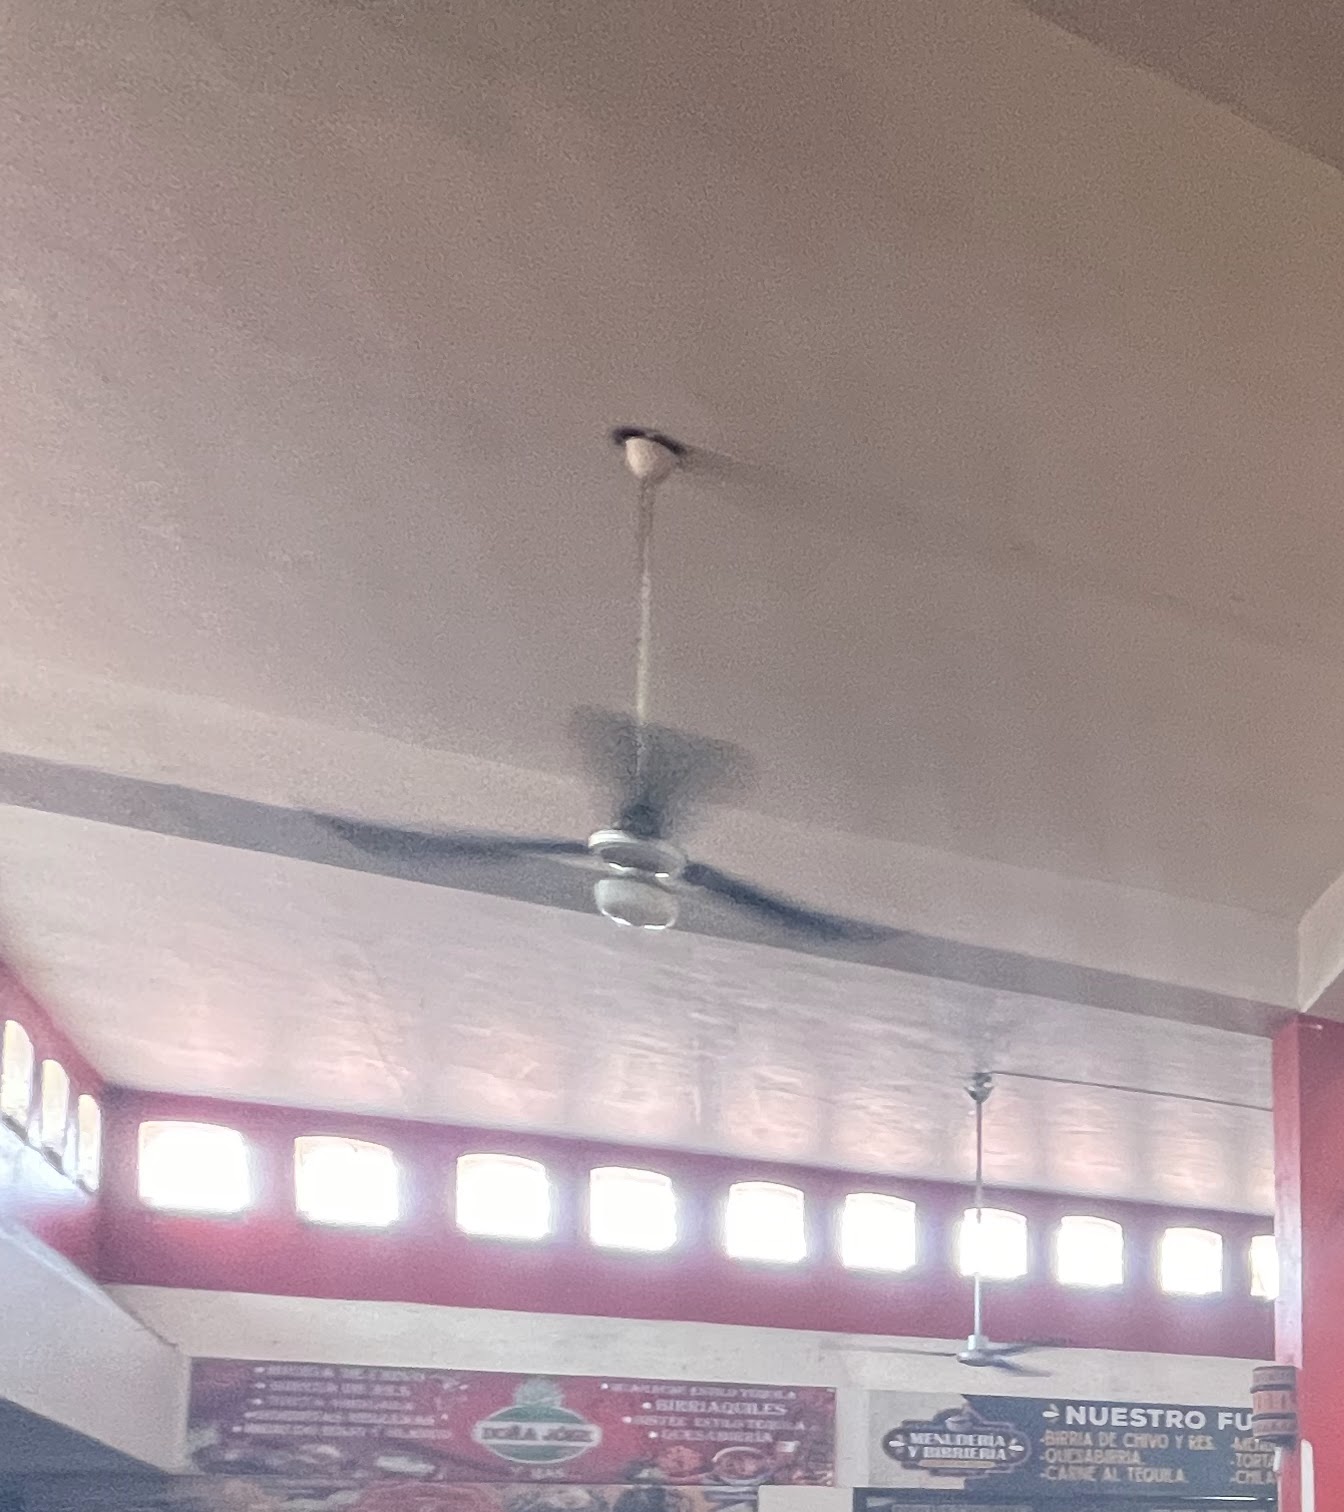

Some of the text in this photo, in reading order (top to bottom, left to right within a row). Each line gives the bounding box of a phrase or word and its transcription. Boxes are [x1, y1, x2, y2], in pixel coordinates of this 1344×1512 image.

[1065, 1405, 1253, 1431] NUESTRO FU
[1098, 1431, 1118, 1448] DE
[1123, 1432, 1170, 1449] CHIVO
[1174, 1434, 1184, 1449] Y
[1102, 1466, 1121, 1481] AL
